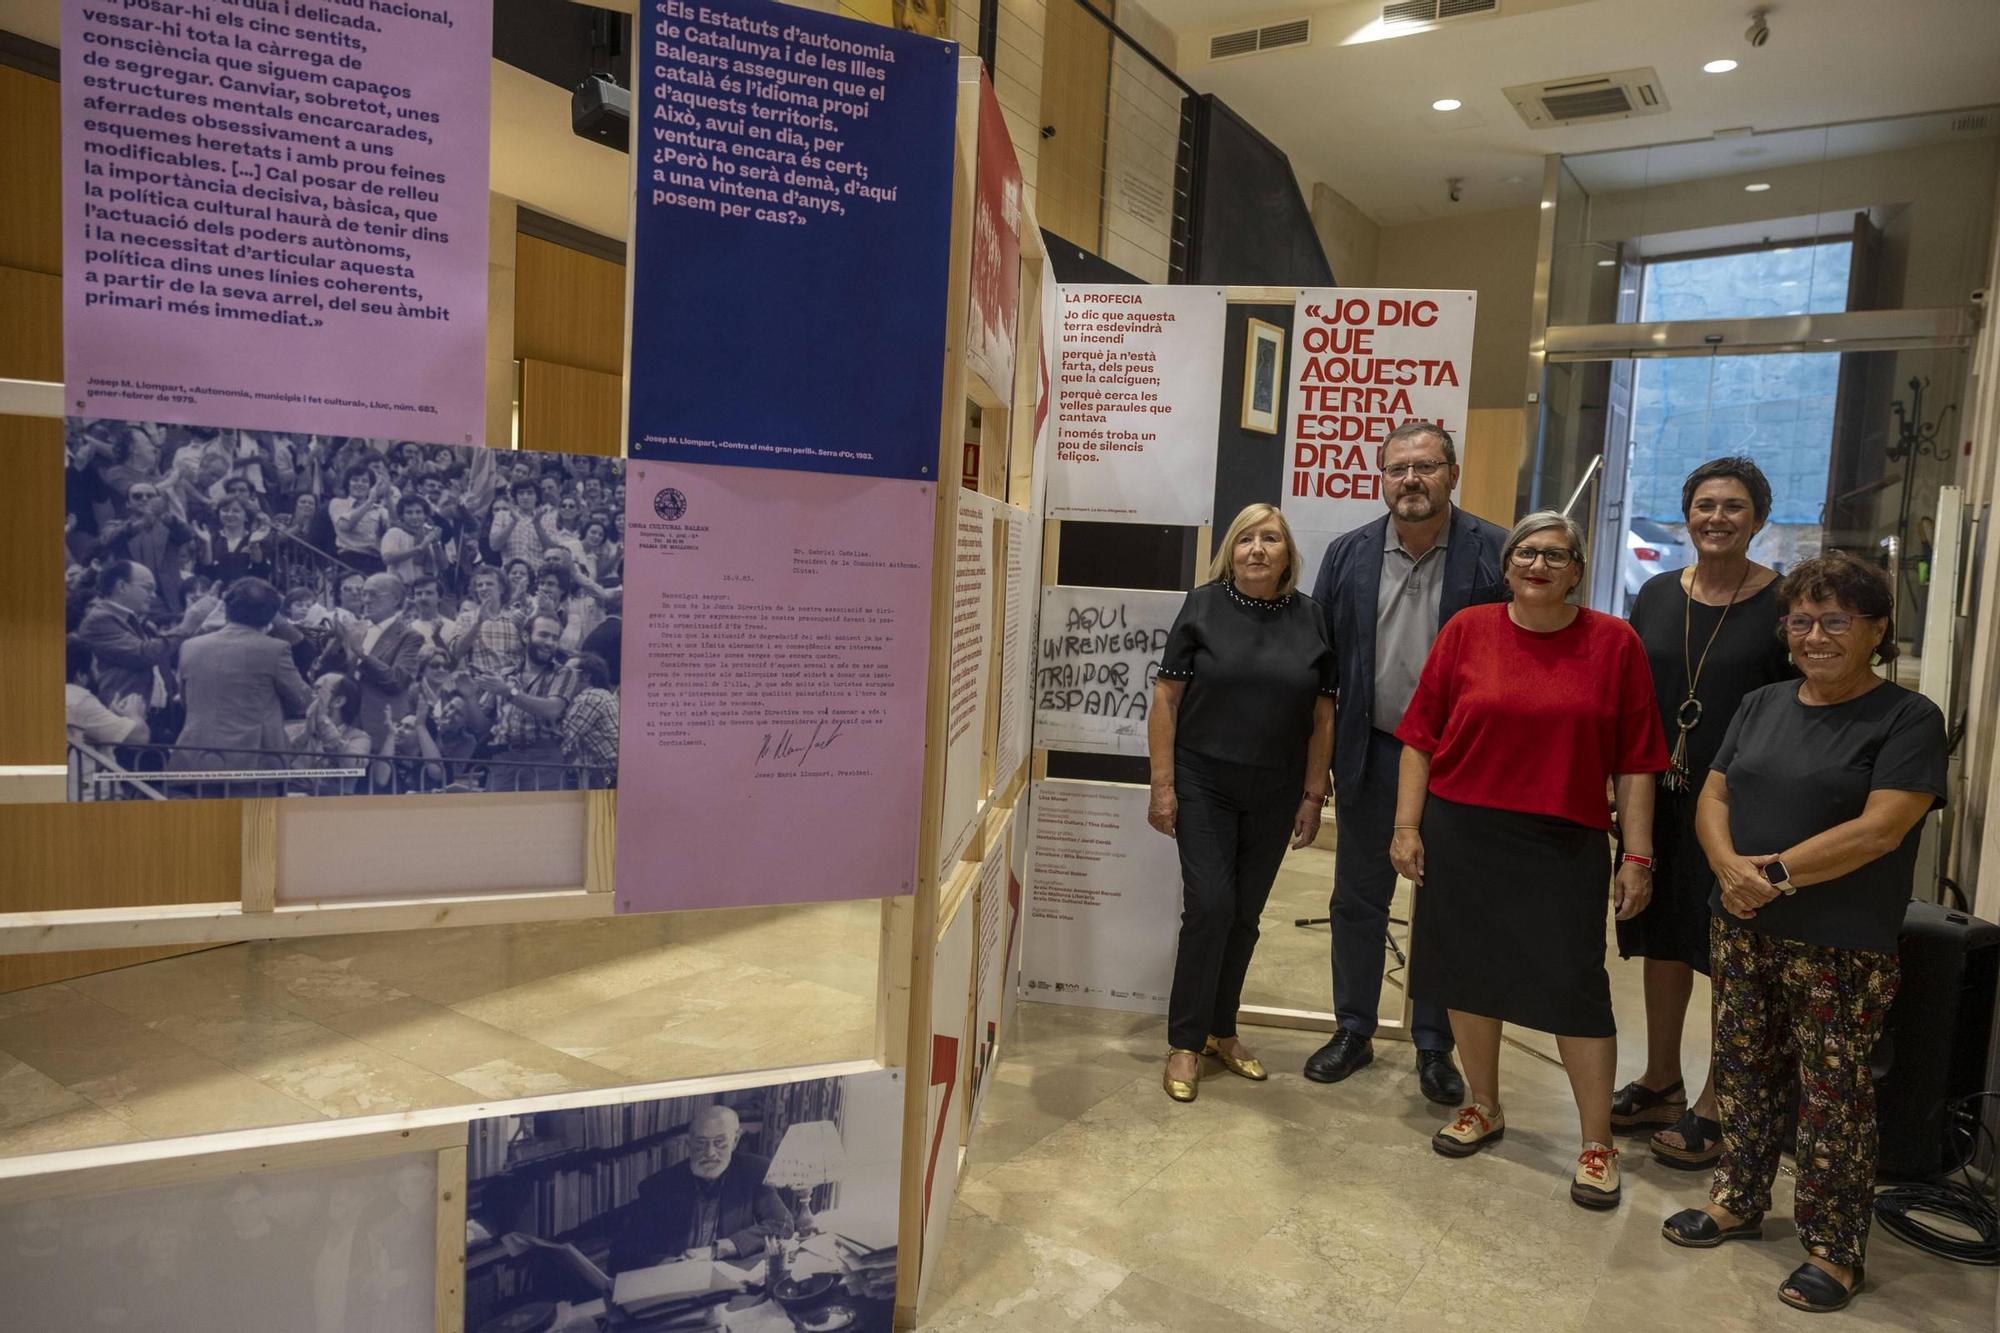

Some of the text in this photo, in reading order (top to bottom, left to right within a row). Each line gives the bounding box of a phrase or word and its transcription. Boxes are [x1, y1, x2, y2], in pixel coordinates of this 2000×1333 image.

[82, 9, 362, 70] vessar-hi tota la càrrega de
[215, 11, 243, 27] els
[249, 17, 289, 36] cinc
[295, 28, 366, 53] sentits,
[655, 0, 895, 63] «Els Estatuts d’autonomia
[83, 31, 410, 98] consciència que siguem capaços
[655, 40, 884, 100] Balears asseguren que el
[83, 50, 439, 123] de segregar. Canviar, sobretot, unes
[654, 65, 868, 119] català és l’idioma propi
[83, 75, 432, 144] estructures mentals encarcarades,
[654, 83, 838, 132] d’aquests territoris.
[84, 95, 393, 156] aferrades obsessivament a uns
[653, 104, 844, 152] Això, avui en dia, per
[653, 127, 867, 180] ventura encara és cert;
[653, 147, 897, 202] ¿Però ho serà demà, d’aquí
[653, 189, 806, 224] posem per cas?»
[85, 202, 410, 261] l’actuació dels poders autònoms,
[85, 249, 422, 301] política dins unes línies coherents,
[85, 290, 323, 326] primari més immediat.»
[1065, 294, 1142, 304] LA PROFECIA
[1304, 299, 1439, 327] «JO DIC
[1063, 321, 1161, 332] terra esdevindrà
[1064, 309, 1175, 323] Jo dic que aquesta
[1080, 332, 1124, 343] incendi
[1302, 327, 1375, 354] QUE
[1062, 349, 1156, 362] perquè ja n’està
[1062, 360, 1153, 376] farta, dels peus
[1061, 374, 1082, 384] que
[1085, 372, 1096, 382] la
[1300, 357, 1459, 387] AQUESTA
[1059, 400, 1171, 415] velles paraules que
[1060, 389, 1157, 401] perquè cerca les
[1300, 386, 1414, 414] TERRA
[1059, 413, 1106, 422] cantava
[1296, 414, 1456, 443] ESDEV-
[1057, 440, 1143, 451] pou de silencis
[1057, 450, 1099, 463] feliços.
[1294, 441, 1367, 471] DRÀ
[1066, 603, 1127, 633] AQUI
[1037, 662, 1129, 688] TRAIDOR
[1039, 683, 1148, 720] ESPAÑA
